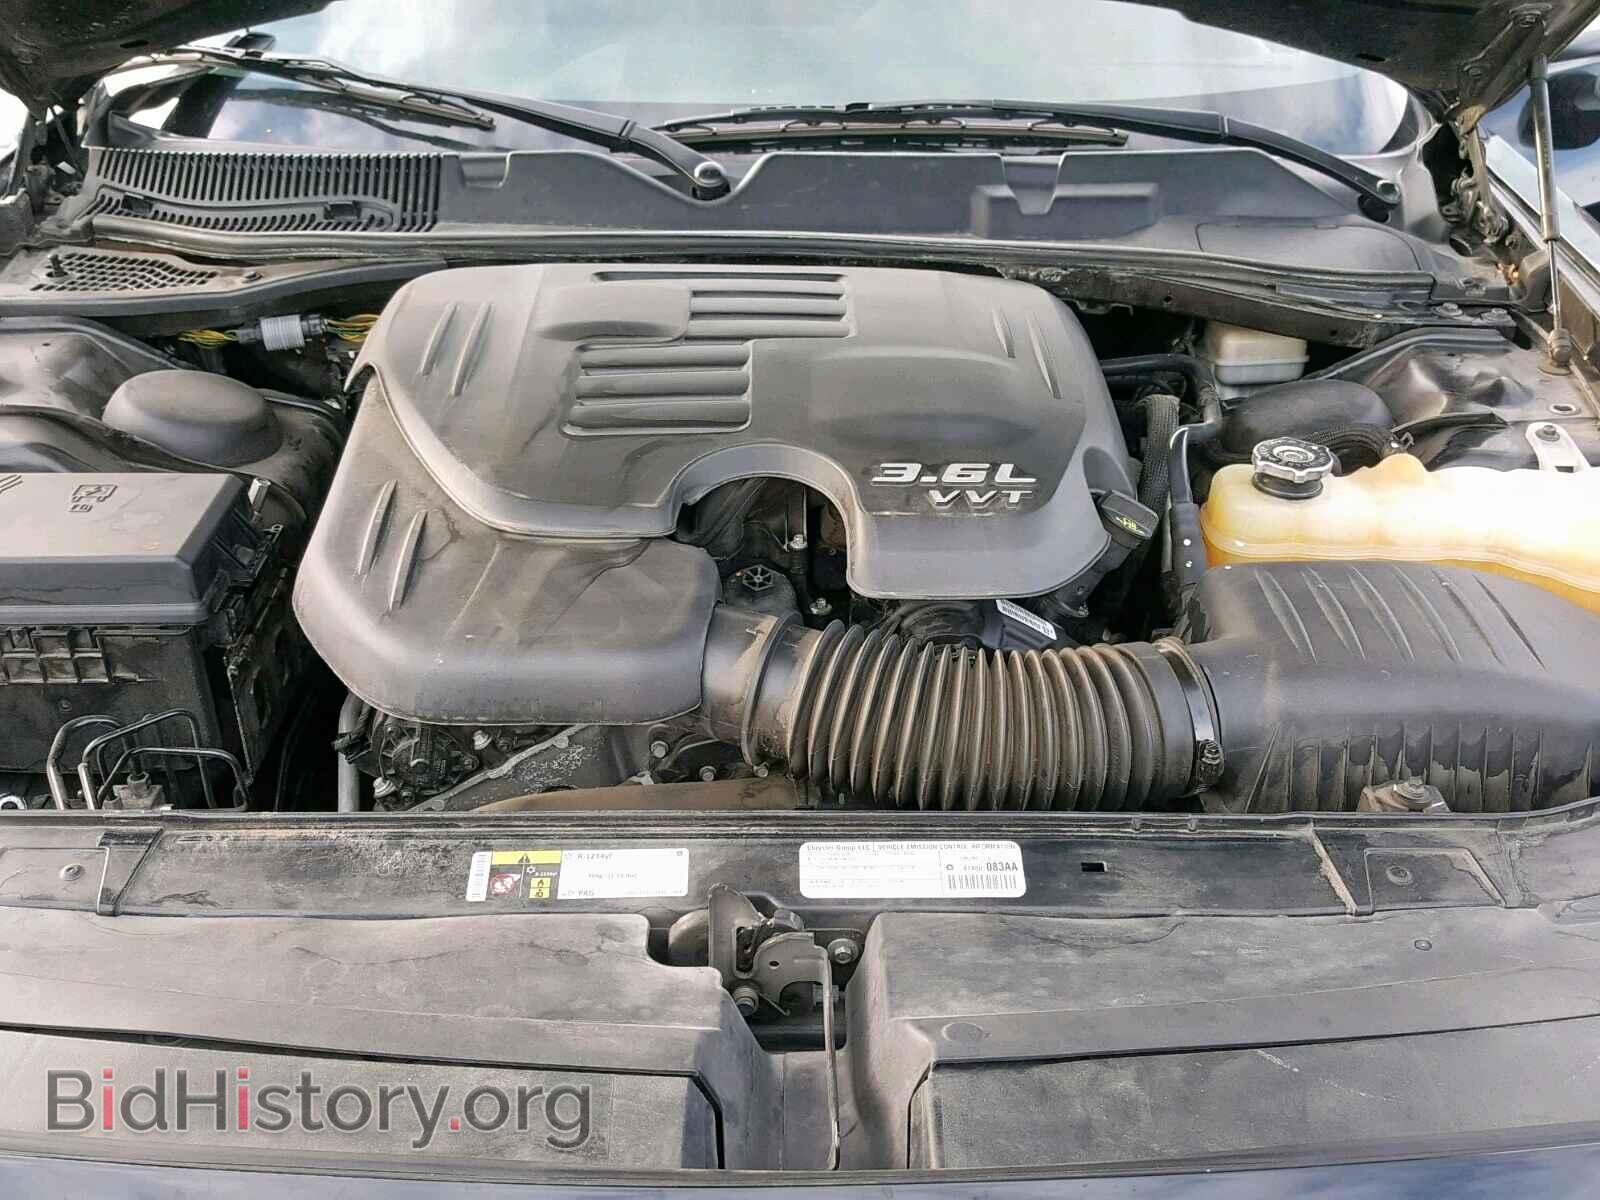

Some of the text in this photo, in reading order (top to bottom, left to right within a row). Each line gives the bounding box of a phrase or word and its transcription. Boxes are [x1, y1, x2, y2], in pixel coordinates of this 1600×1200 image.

[870, 462, 1038, 486] 3.6L
[928, 490, 1033, 509] VVT
[986, 862, 1018, 872] 083AA
